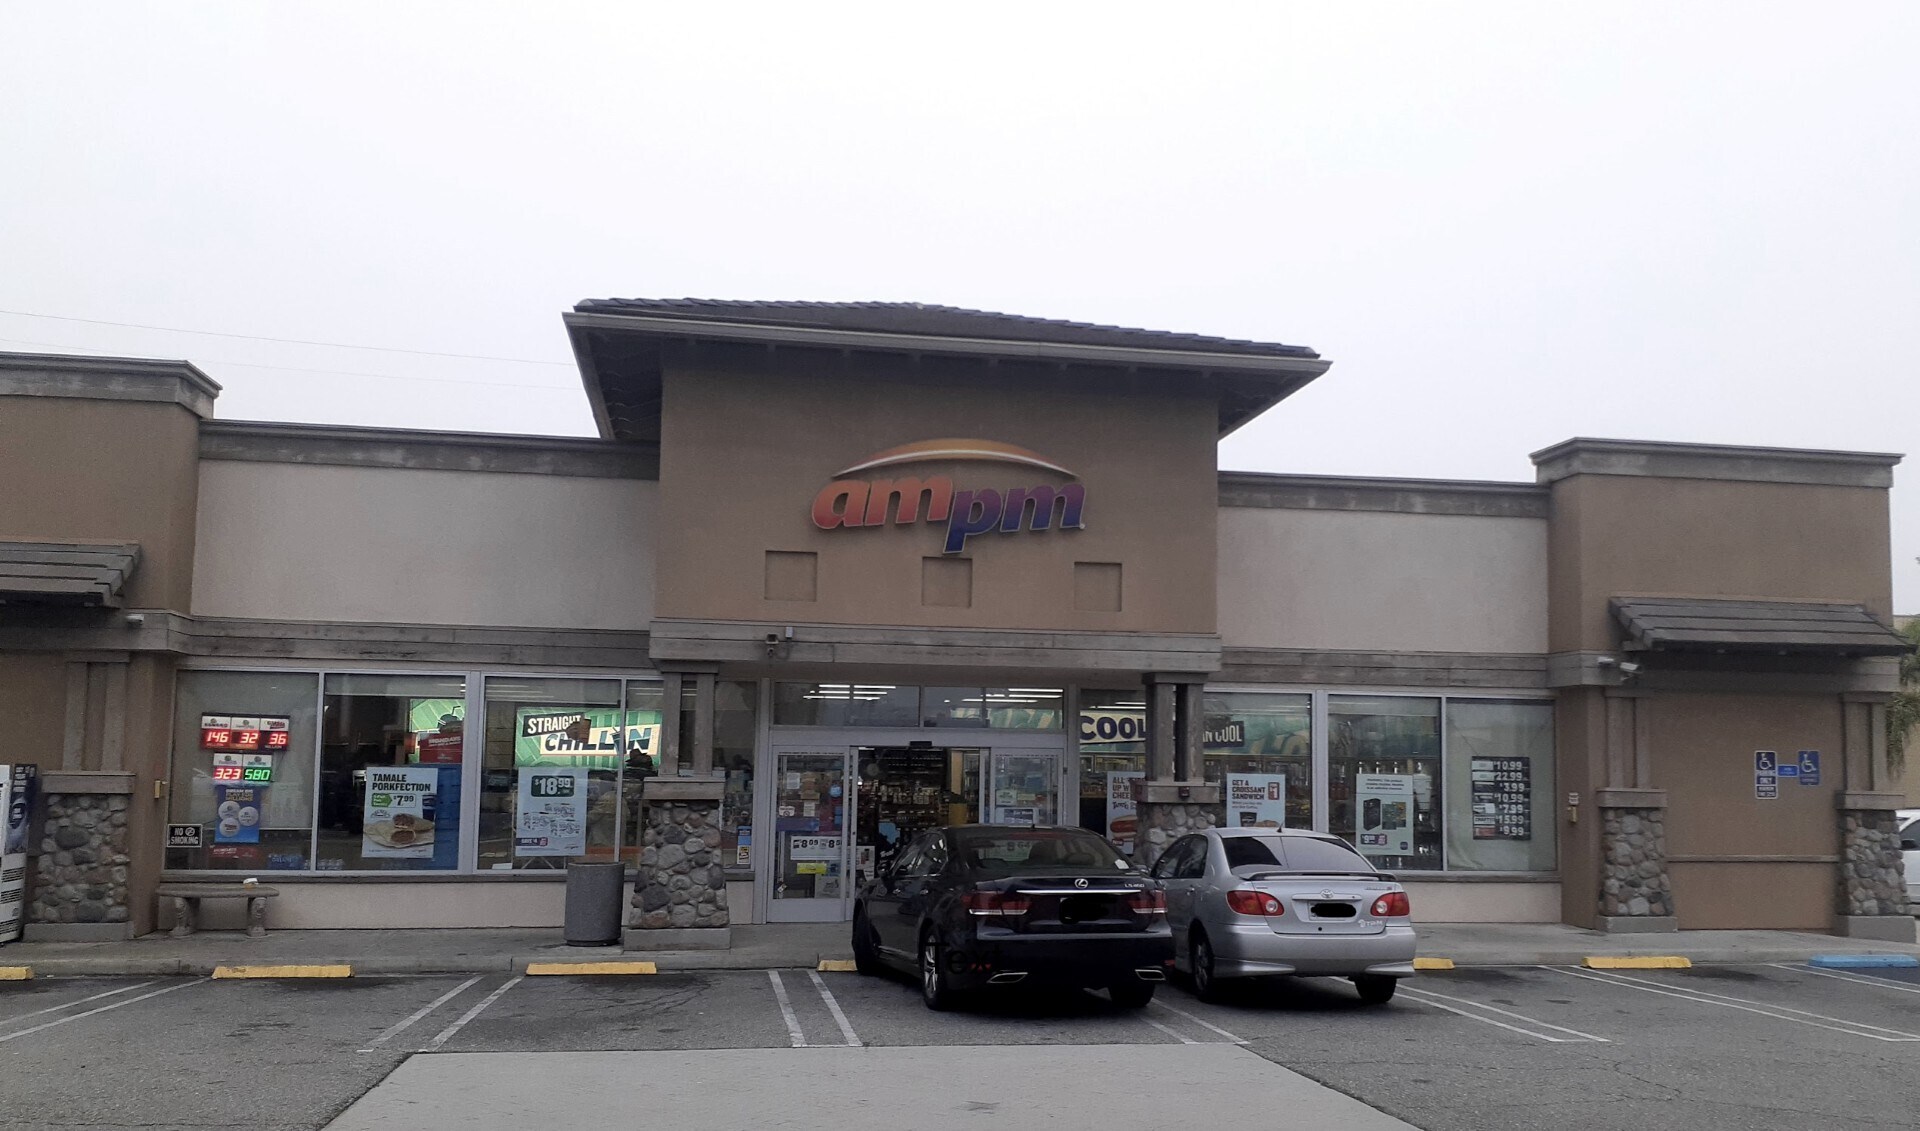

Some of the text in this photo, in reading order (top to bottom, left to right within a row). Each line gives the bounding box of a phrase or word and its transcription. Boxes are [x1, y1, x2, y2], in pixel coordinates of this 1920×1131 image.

[811, 476, 1086, 553] ampm
[206, 731, 229, 743] 146
[240, 732, 259, 744] 32
[269, 733, 287, 745] 36
[545, 727, 653, 751] CHLLN
[214, 768, 241, 780] 323
[244, 769, 270, 781] 580
[372, 773, 407, 782] TAMALE
[372, 783, 431, 791] PORKFECTION
[171, 836, 198, 844] SMOKING
